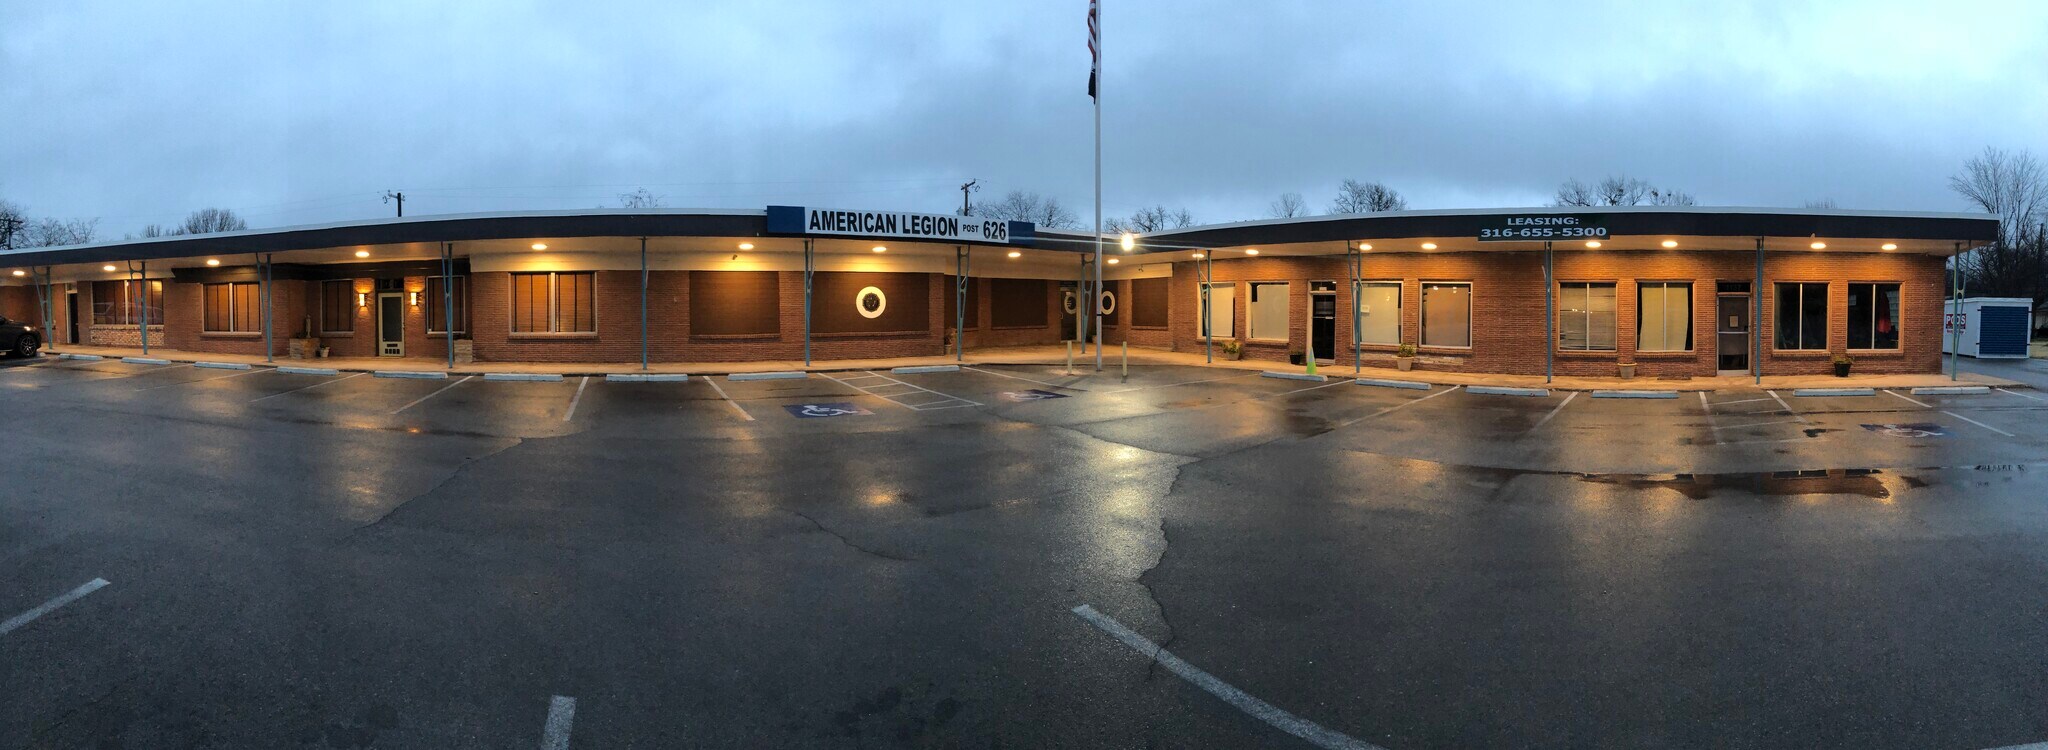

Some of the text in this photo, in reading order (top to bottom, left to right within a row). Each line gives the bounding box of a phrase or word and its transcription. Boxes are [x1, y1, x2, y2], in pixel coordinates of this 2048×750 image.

[809, 210, 1006, 240] AMERICAN LEGION POST 626
[1507, 217, 1579, 226] LEASING:
[1481, 227, 1607, 238] 316-655-5300
